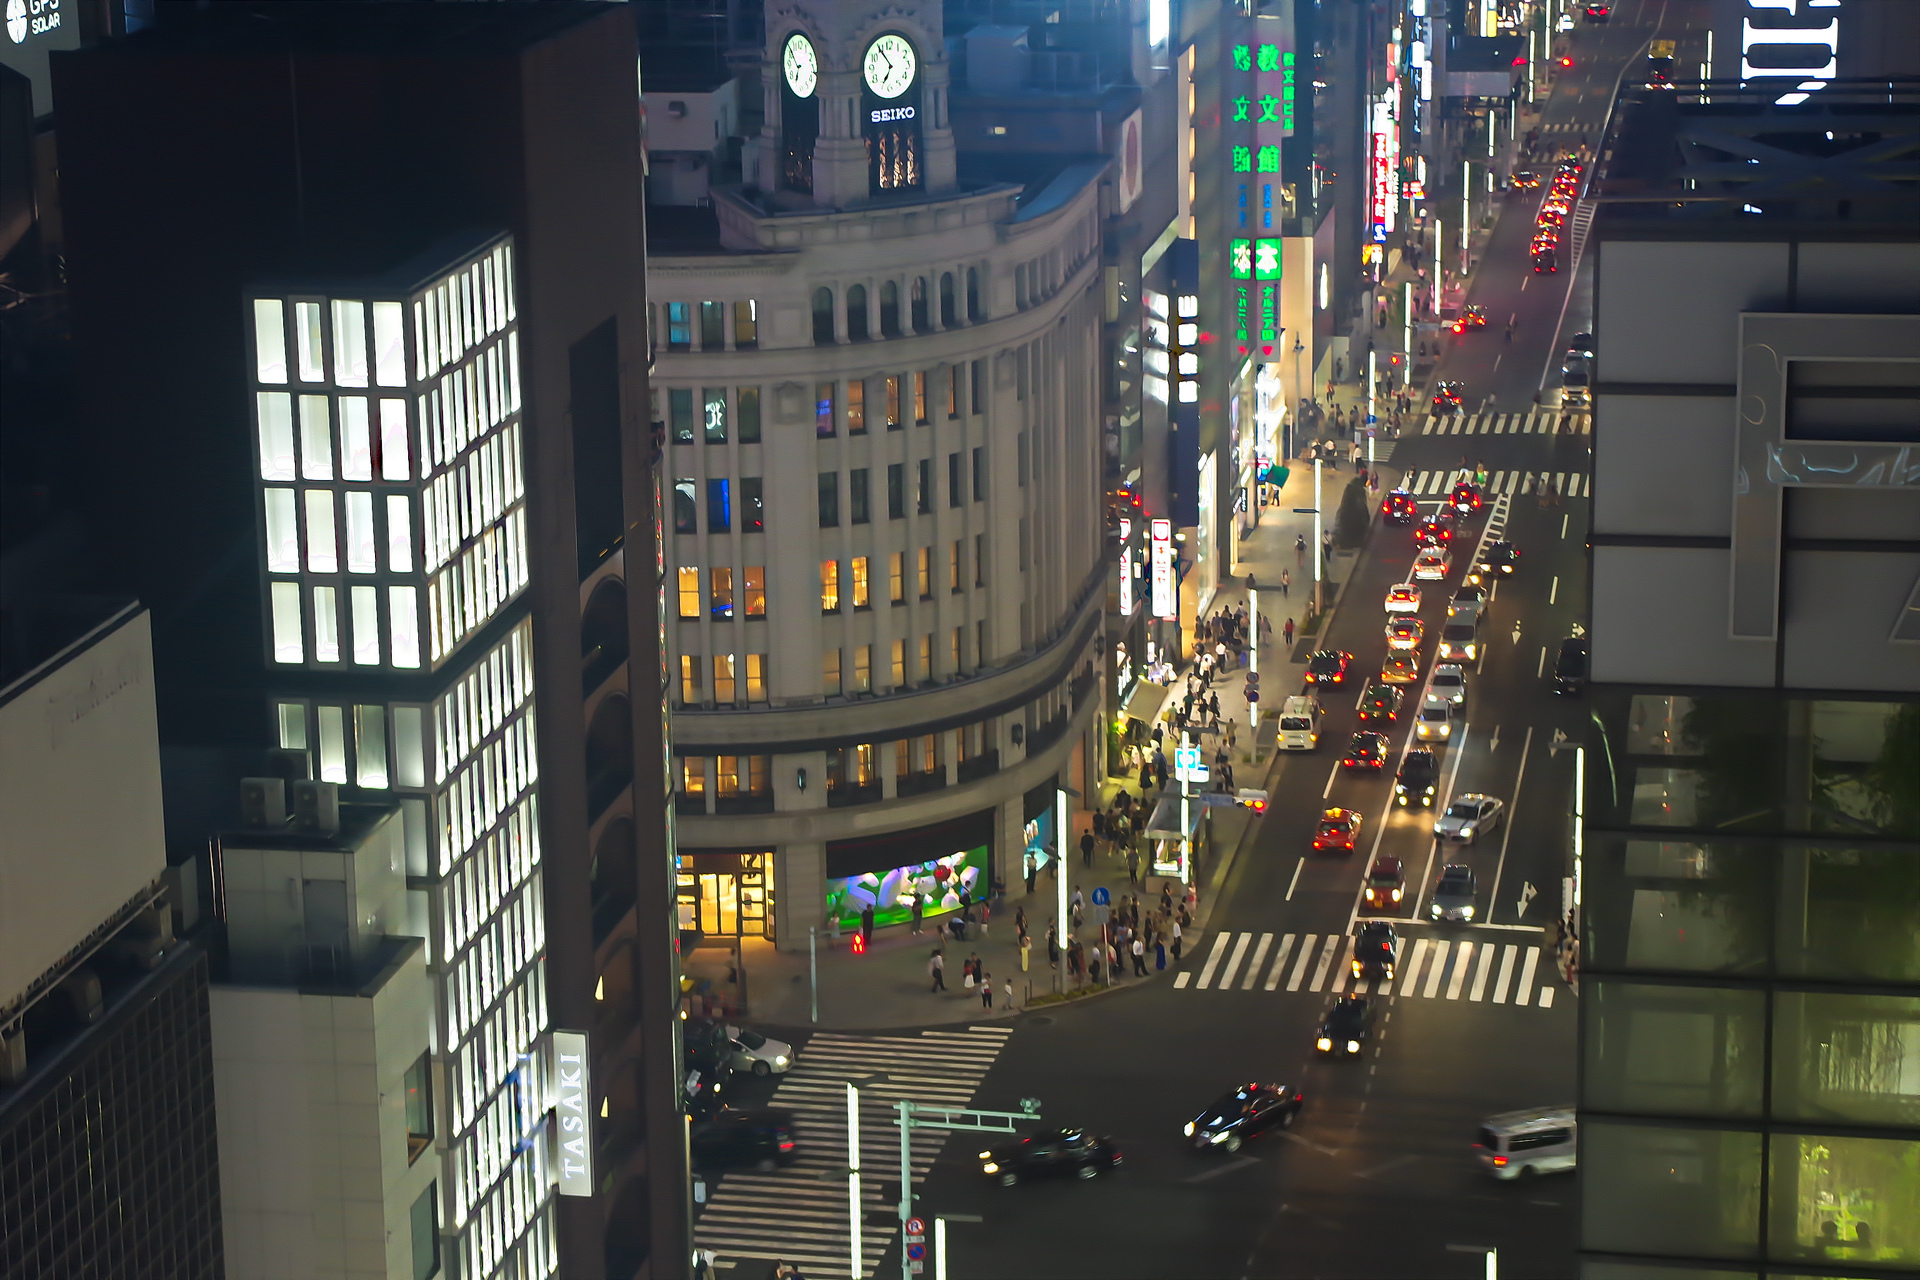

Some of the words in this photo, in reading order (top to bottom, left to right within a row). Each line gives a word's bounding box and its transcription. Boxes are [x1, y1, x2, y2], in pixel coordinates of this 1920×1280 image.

[31, 11, 61, 35] SOLAR
[871, 106, 915, 123] SEIKO
[1257, 44, 1280, 173] 教文館
[1255, 244, 1279, 274] 本
[560, 1053, 585, 1179] TASAKI
